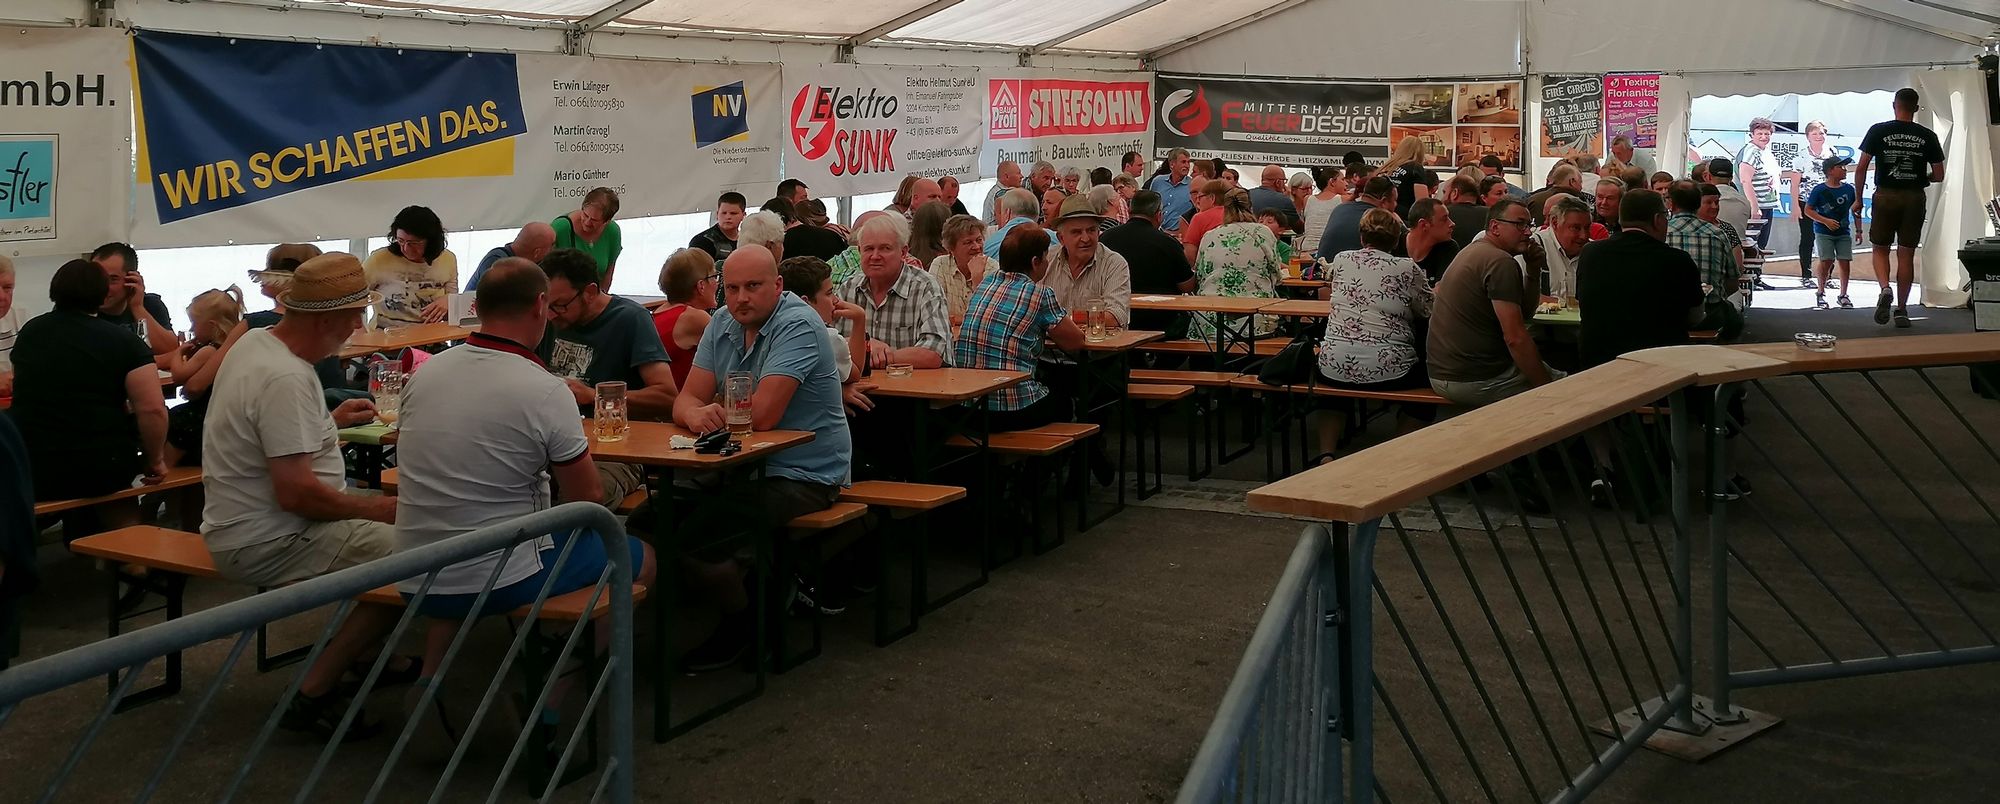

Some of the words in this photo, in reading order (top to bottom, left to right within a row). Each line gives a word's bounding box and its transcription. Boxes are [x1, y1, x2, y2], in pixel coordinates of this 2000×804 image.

[553, 80, 580, 90] Erwin
[906, 77, 928, 87] Elektro
[1546, 87, 1564, 98] FIRE
[1567, 82, 1596, 94] CIRCUS
[554, 97, 568, 107] Tel.
[713, 94, 742, 117] NV
[814, 87, 898, 119] Elektro
[1029, 89, 1144, 129] STIEFSOHN
[1244, 102, 1384, 115] MITTERHAUSER
[1544, 107, 1558, 117] 28.
[1559, 106, 1566, 114] &
[1568, 104, 1582, 113] 29.
[1583, 100, 1600, 111] JULI
[992, 106, 1017, 128] Profi
[1549, 115, 1573, 124] FF-FEST
[553, 125, 584, 135] Martin
[1883, 134, 1926, 146] FEUERWEHR
[554, 142, 568, 152] Tel.
[830, 128, 898, 177] SUNK
[159, 160, 246, 208] WIR
[248, 116, 431, 188] SCHAFFEN
[440, 100, 508, 144] DAS.
[554, 170, 580, 181] Mario
[583, 169, 609, 180] Günther
[553, 187, 568, 198] Tel.
